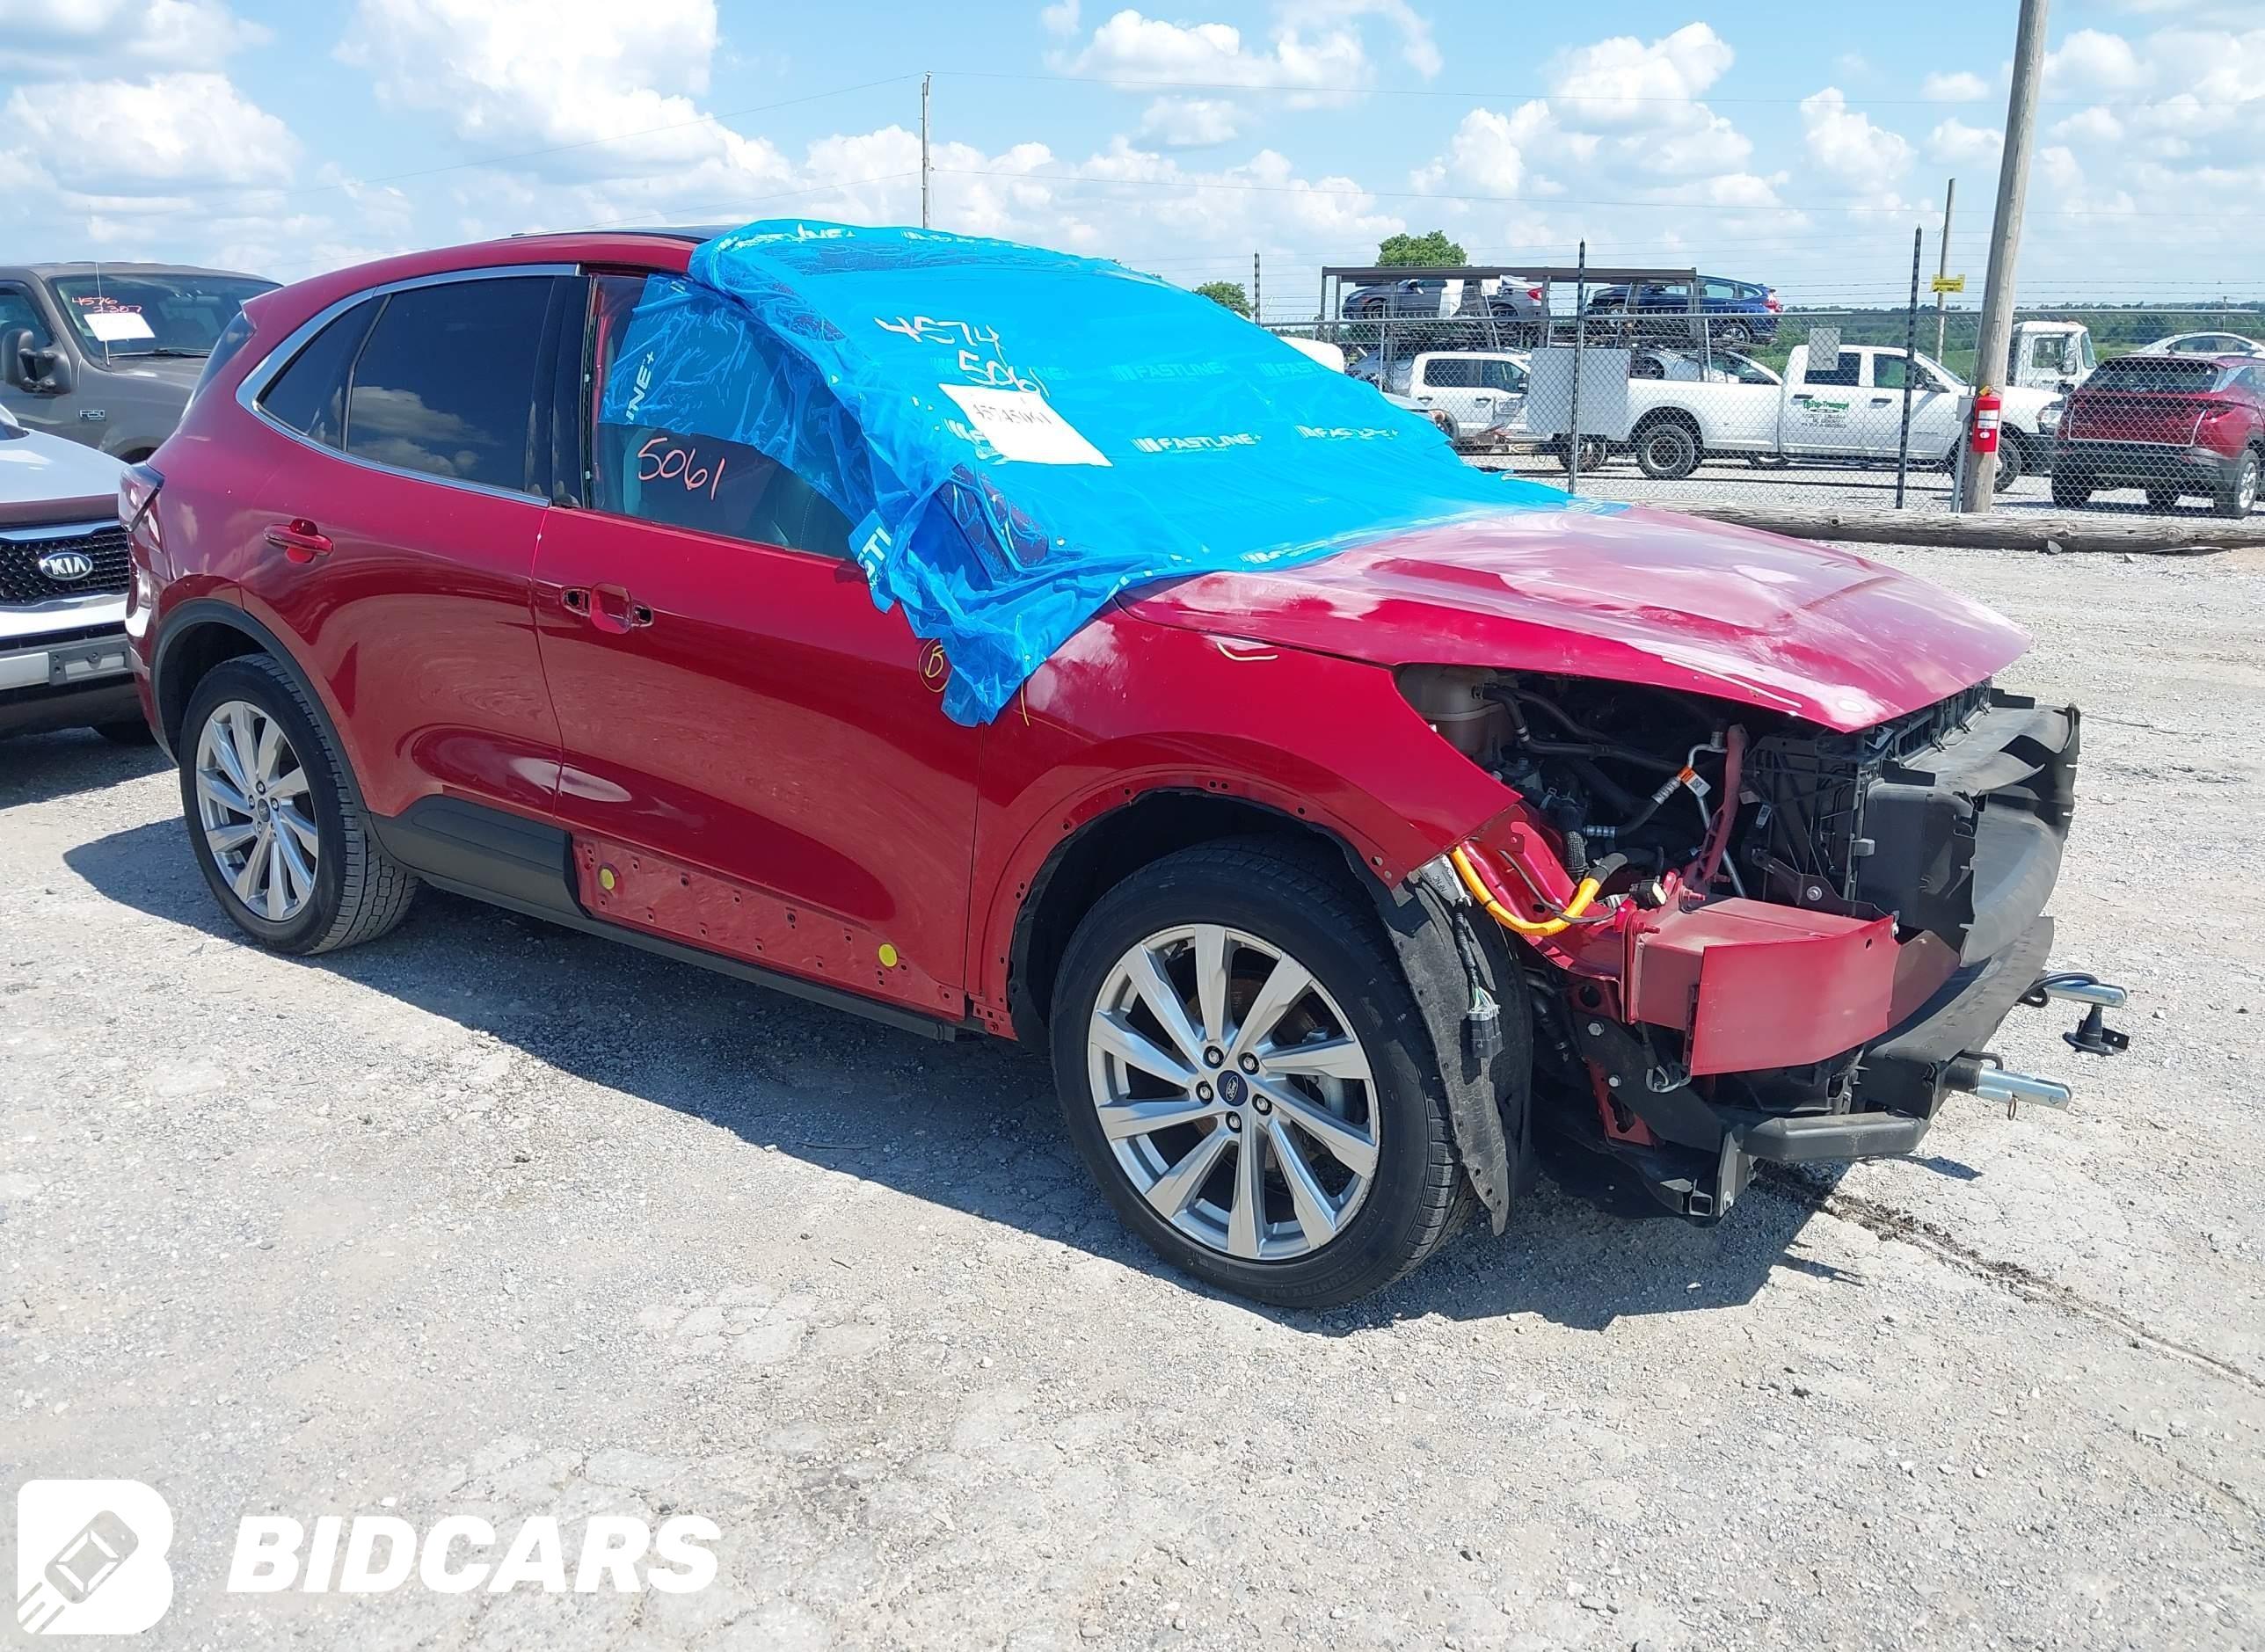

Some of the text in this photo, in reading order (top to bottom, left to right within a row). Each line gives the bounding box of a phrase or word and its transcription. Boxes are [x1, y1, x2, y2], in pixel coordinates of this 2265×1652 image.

[958, 350, 1050, 398] 5061
[637, 437, 725, 500] 5061
[48, 557, 87, 575] KIA
